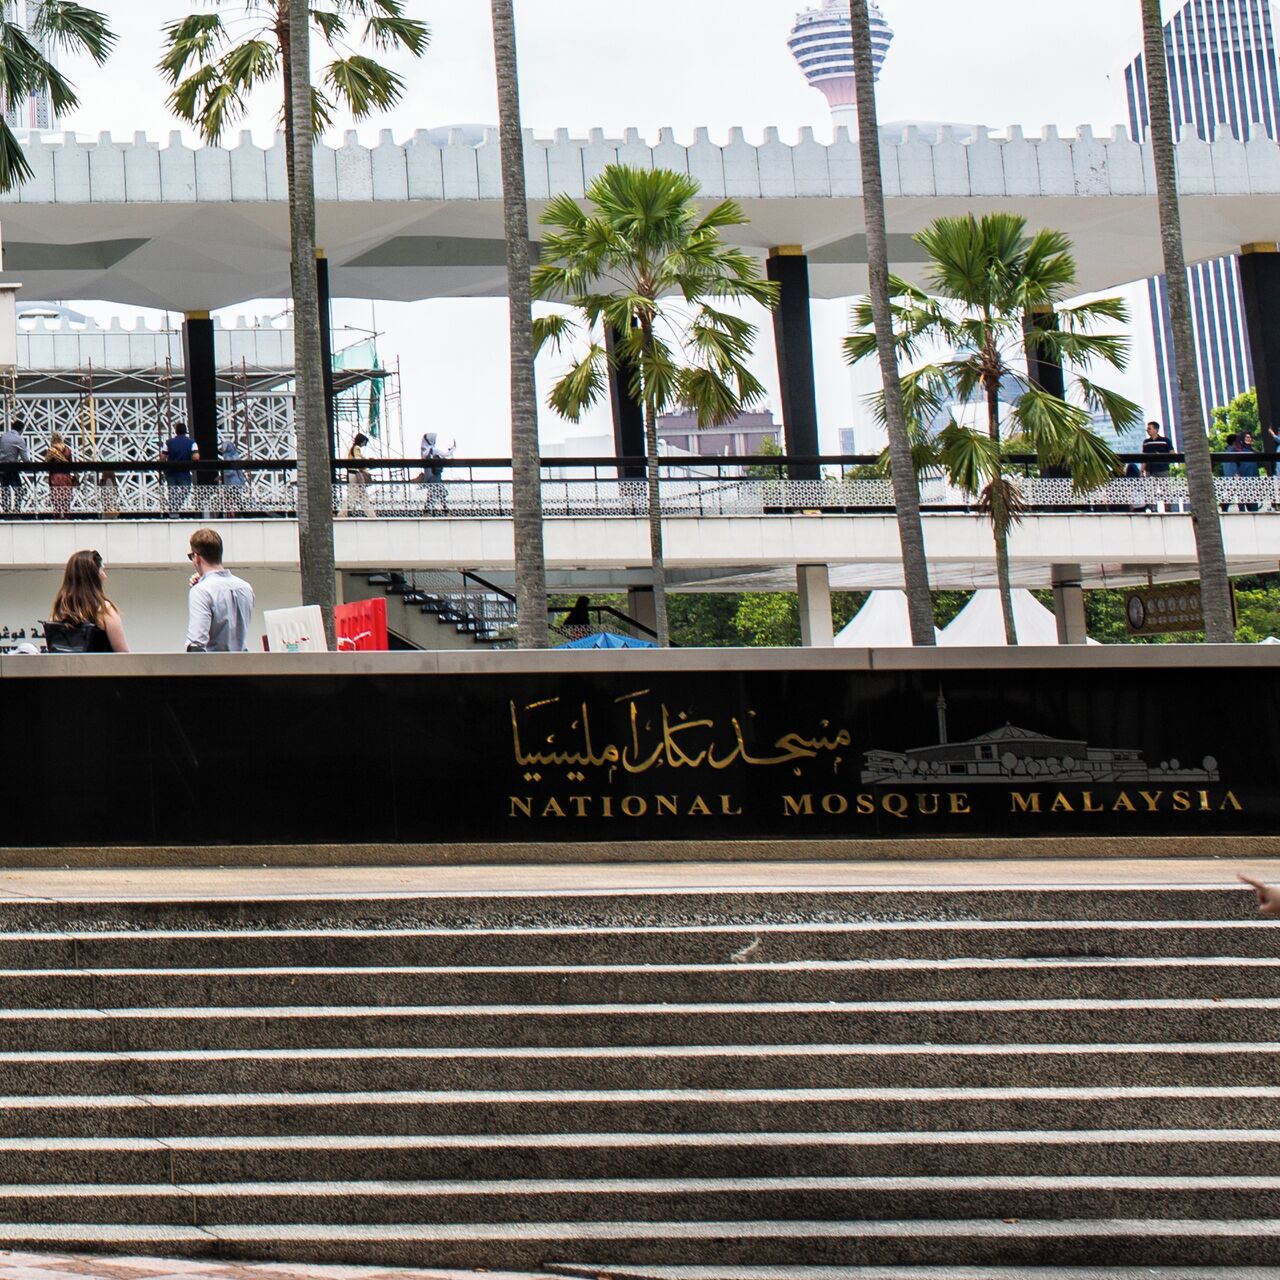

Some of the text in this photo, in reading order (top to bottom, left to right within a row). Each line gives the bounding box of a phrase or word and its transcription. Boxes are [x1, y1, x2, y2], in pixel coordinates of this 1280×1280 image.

[509, 789, 1243, 818] NATIONAL MOSQUE MALAYSIA
